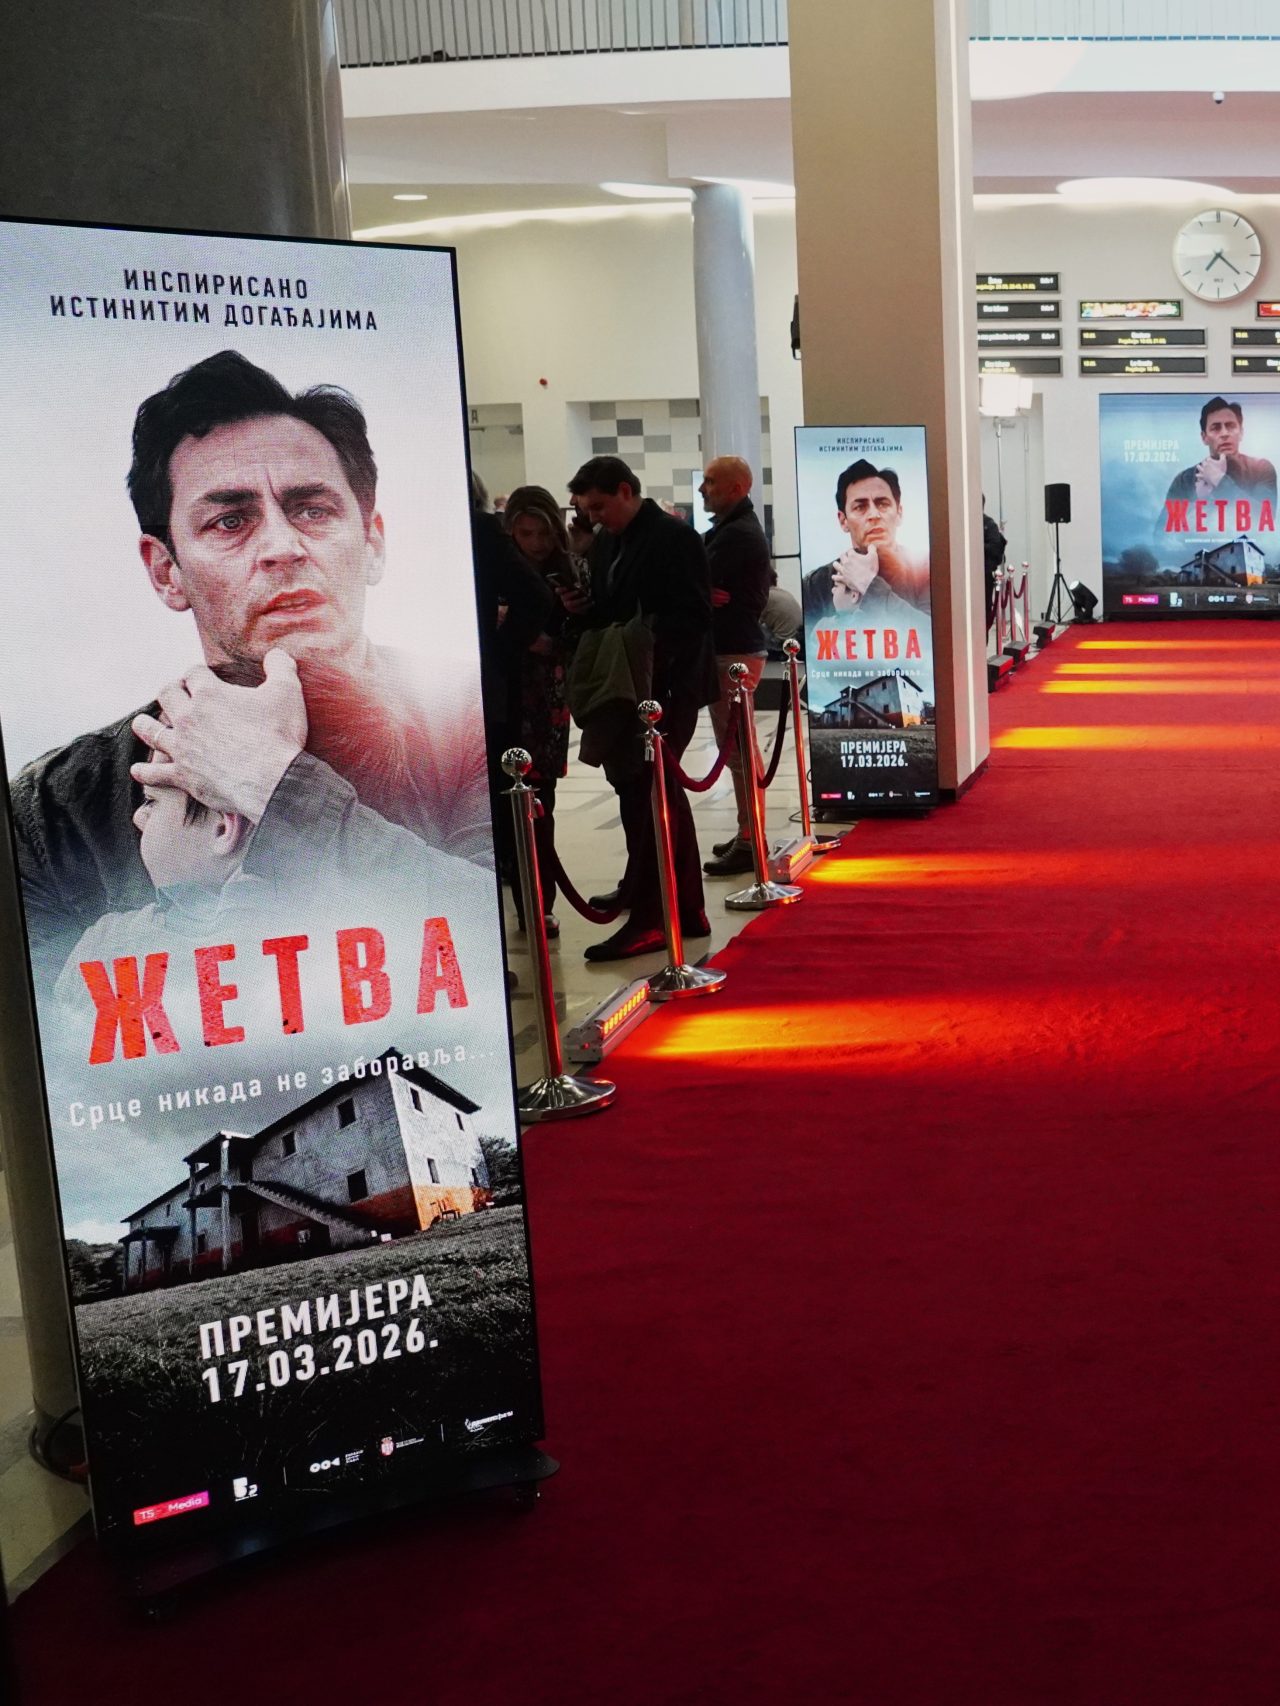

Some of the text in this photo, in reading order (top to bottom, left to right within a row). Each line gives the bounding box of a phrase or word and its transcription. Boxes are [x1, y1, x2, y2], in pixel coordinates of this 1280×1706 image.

[124, 269, 308, 300] ИНСПИРИСАНО
[50, 296, 378, 331] ИСТИНИТИМ ДОГАЂАЈИМА
[1124, 440, 1180, 450] ПРЕМИЈЕРА
[1164, 499, 1275, 533] ЖЕТВА
[816, 628, 922, 660] ЖЕТВА
[840, 740, 907, 754] ПРЕМИЈЕРА
[840, 754, 908, 767] 17.03.2026.
[79, 916, 468, 1065] ЖЕТВА
[69, 1046, 496, 1127] Срце никада не заборавља...
[200, 1274, 432, 1360] ПРЕМИЈЕРА
[201, 1318, 439, 1403] 17.03.2026.
[168, 1497, 202, 1512] Media
